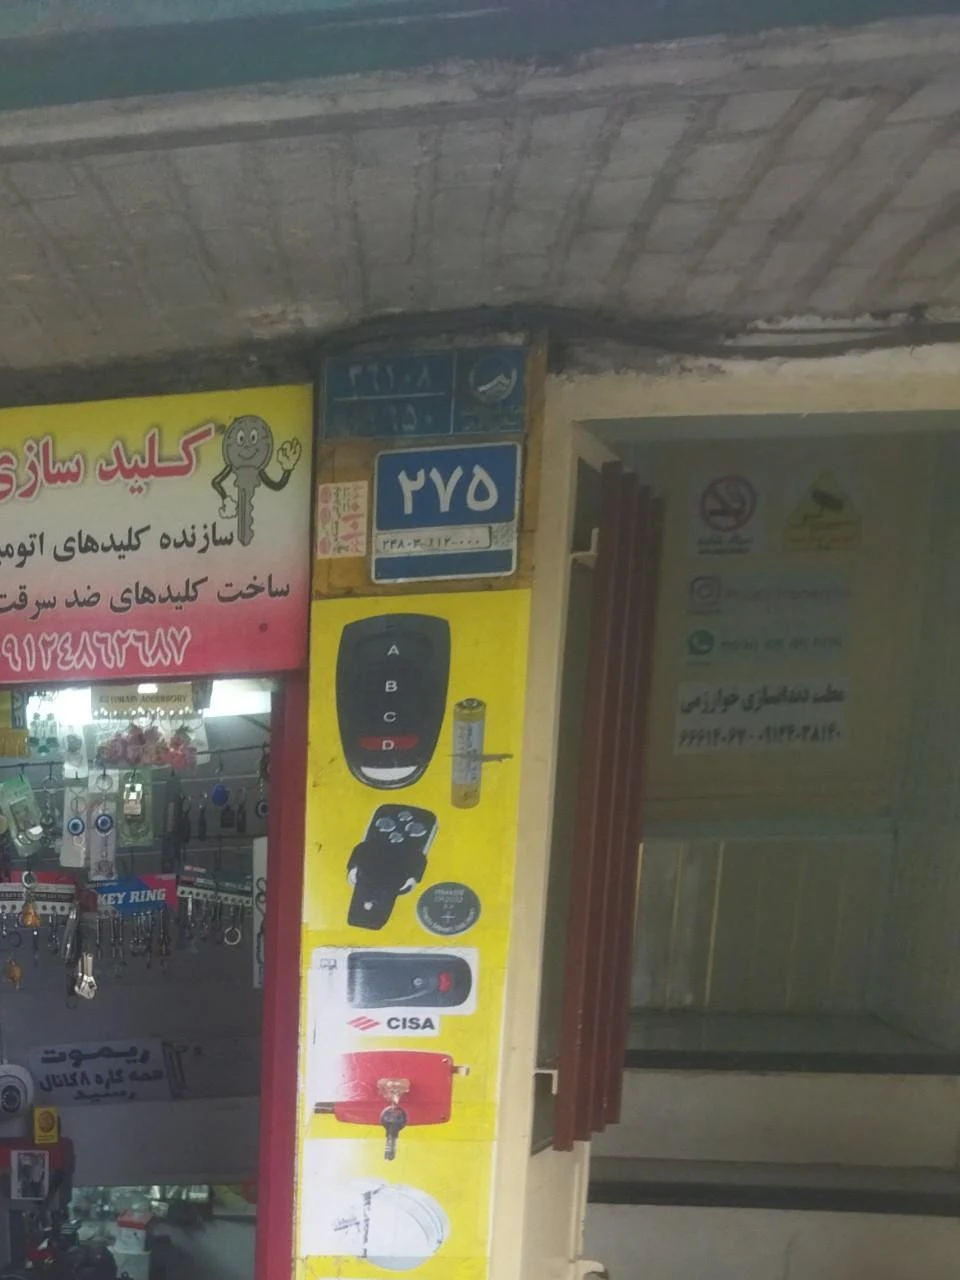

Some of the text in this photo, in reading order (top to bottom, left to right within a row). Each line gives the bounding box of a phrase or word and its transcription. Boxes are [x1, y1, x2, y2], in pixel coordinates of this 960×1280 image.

[97, 422, 214, 494] کلید
[398, 464, 499, 515] ۲۷۵
[53, 524, 151, 562] کلیدهای
[159, 521, 234, 553] سازنده
[64, 584, 101, 609] ضد
[109, 576, 208, 613] کلیدهای
[216, 573, 290, 604] ساخت
[387, 644, 400, 656] A
[385, 680, 398, 692] B
[383, 711, 397, 722] C
[382, 739, 395, 751] D
[97, 887, 167, 906] KEY RING
[386, 1016, 436, 1031] CISA
[40, 1045, 151, 1069] ریموت
